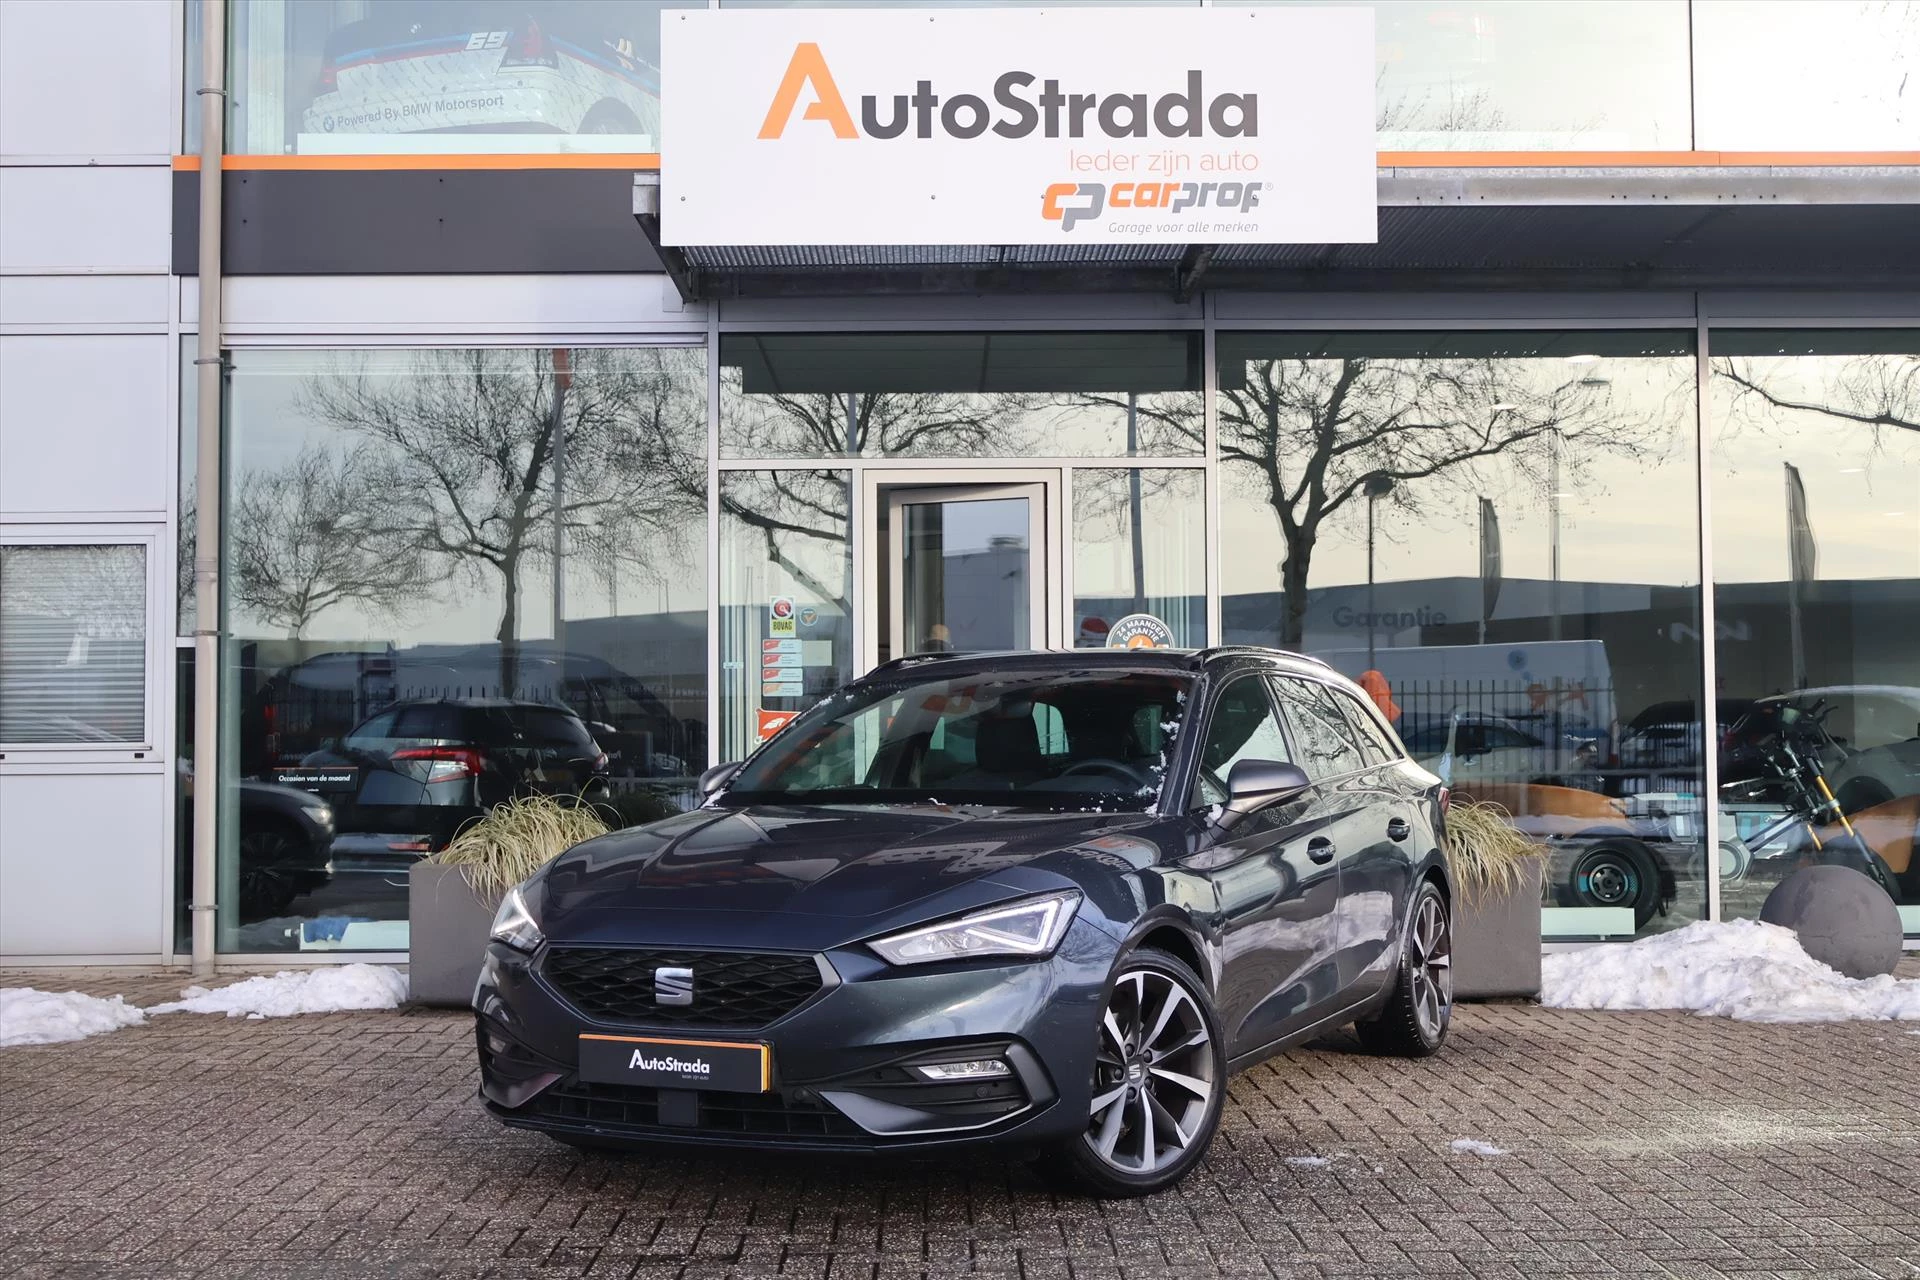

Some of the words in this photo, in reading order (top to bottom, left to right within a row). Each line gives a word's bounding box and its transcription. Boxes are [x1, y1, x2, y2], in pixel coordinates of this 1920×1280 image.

[465, 31, 508, 50] 69
[757, 42, 1258, 140] AutoStrada
[337, 109, 382, 128] Powered
[384, 107, 399, 122] By
[402, 101, 432, 117] BMW
[435, 95, 505, 113] Motorsport
[1070, 149, 1140, 172] Ieder
[1148, 149, 1190, 177] zijn
[1199, 151, 1259, 172] auto
[1108, 221, 1152, 236] Garage
[1156, 223, 1183, 233] voor
[1187, 221, 1210, 233] alle
[1213, 221, 1259, 233] merken
[773, 621, 792, 631] BOVAG
[1332, 605, 1447, 628] Garantie
[1116, 626, 1127, 638] 24
[1127, 620, 1165, 637] MAANDEN
[1122, 627, 1160, 641] GARANTIE
[279, 774, 305, 782] Occasion
[319, 774, 328, 782] de
[328, 773, 351, 782] maand
[628, 1048, 710, 1074] AutoStrada
